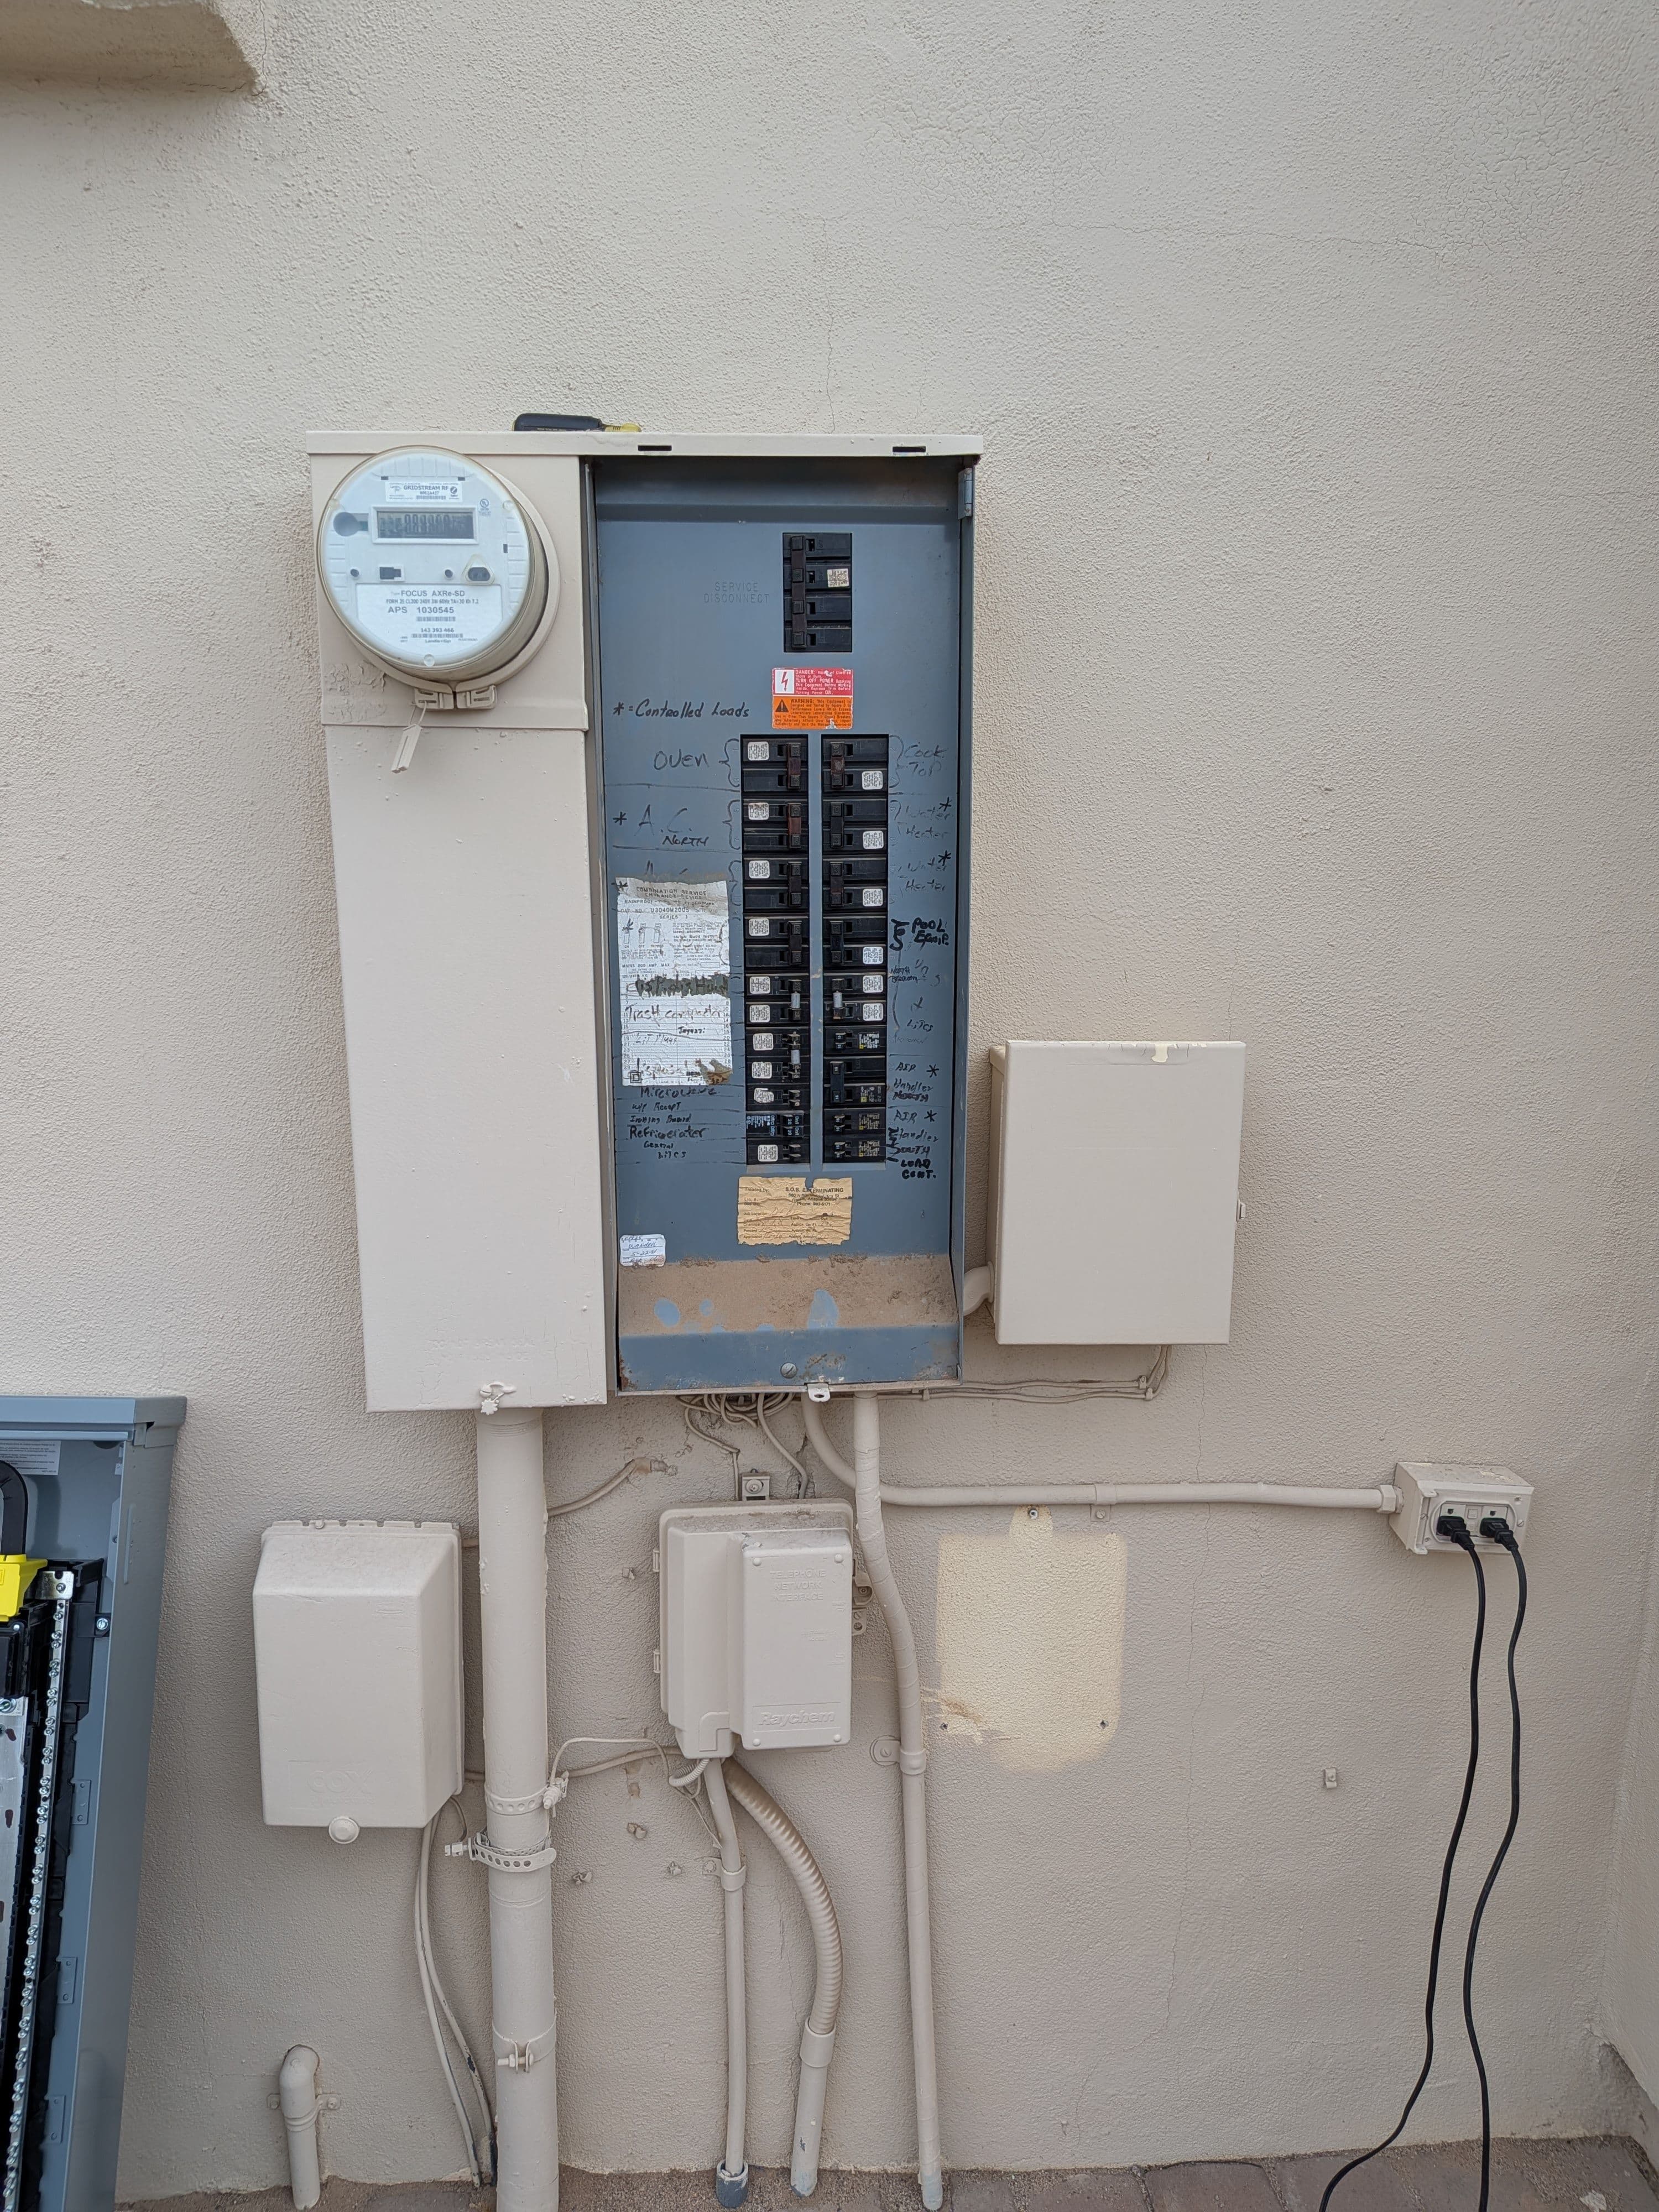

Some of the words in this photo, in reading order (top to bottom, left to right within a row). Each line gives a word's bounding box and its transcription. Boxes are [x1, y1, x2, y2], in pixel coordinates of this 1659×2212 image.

[714, 582, 758, 592] SERVICE
[703, 593, 769, 603] DISCONNECT
[635, 698, 705, 719] Controlled
[712, 702, 750, 718] Loads
[769, 1568, 827, 1579] TELEPHONE
[774, 1580, 823, 1590] NETWORK
[770, 1593, 823, 1602] INTERFACE
[757, 1710, 836, 1727] Raychem
